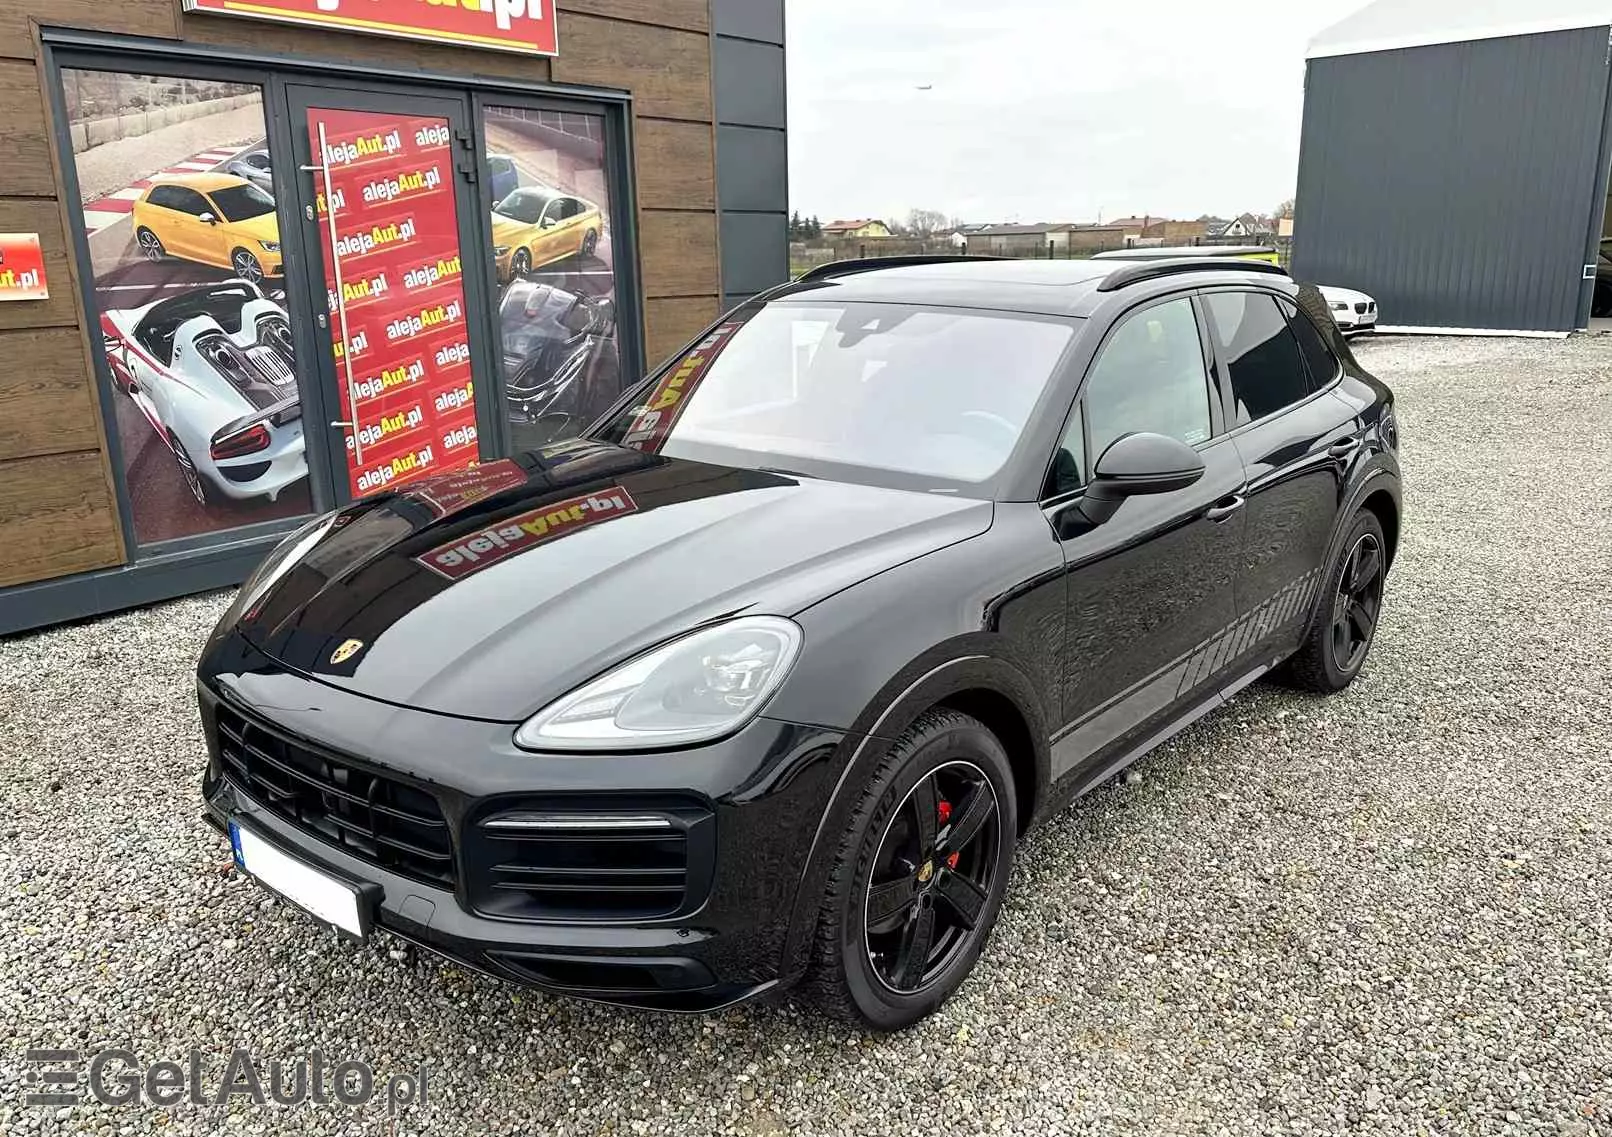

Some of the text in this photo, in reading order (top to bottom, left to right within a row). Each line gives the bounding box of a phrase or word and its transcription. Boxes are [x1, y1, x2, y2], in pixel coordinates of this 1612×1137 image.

[320, 130, 402, 165] lejaAut.pl
[362, 166, 441, 202] alejaAut.pl
[336, 218, 417, 257] alejaAut.pl
[386, 300, 462, 340] alejaAut.pl
[435, 342, 470, 366] aleja
[345, 405, 424, 450] aejaAut.pl
[443, 425, 477, 449] aleja
[357, 445, 434, 490] alejaAut.pl
